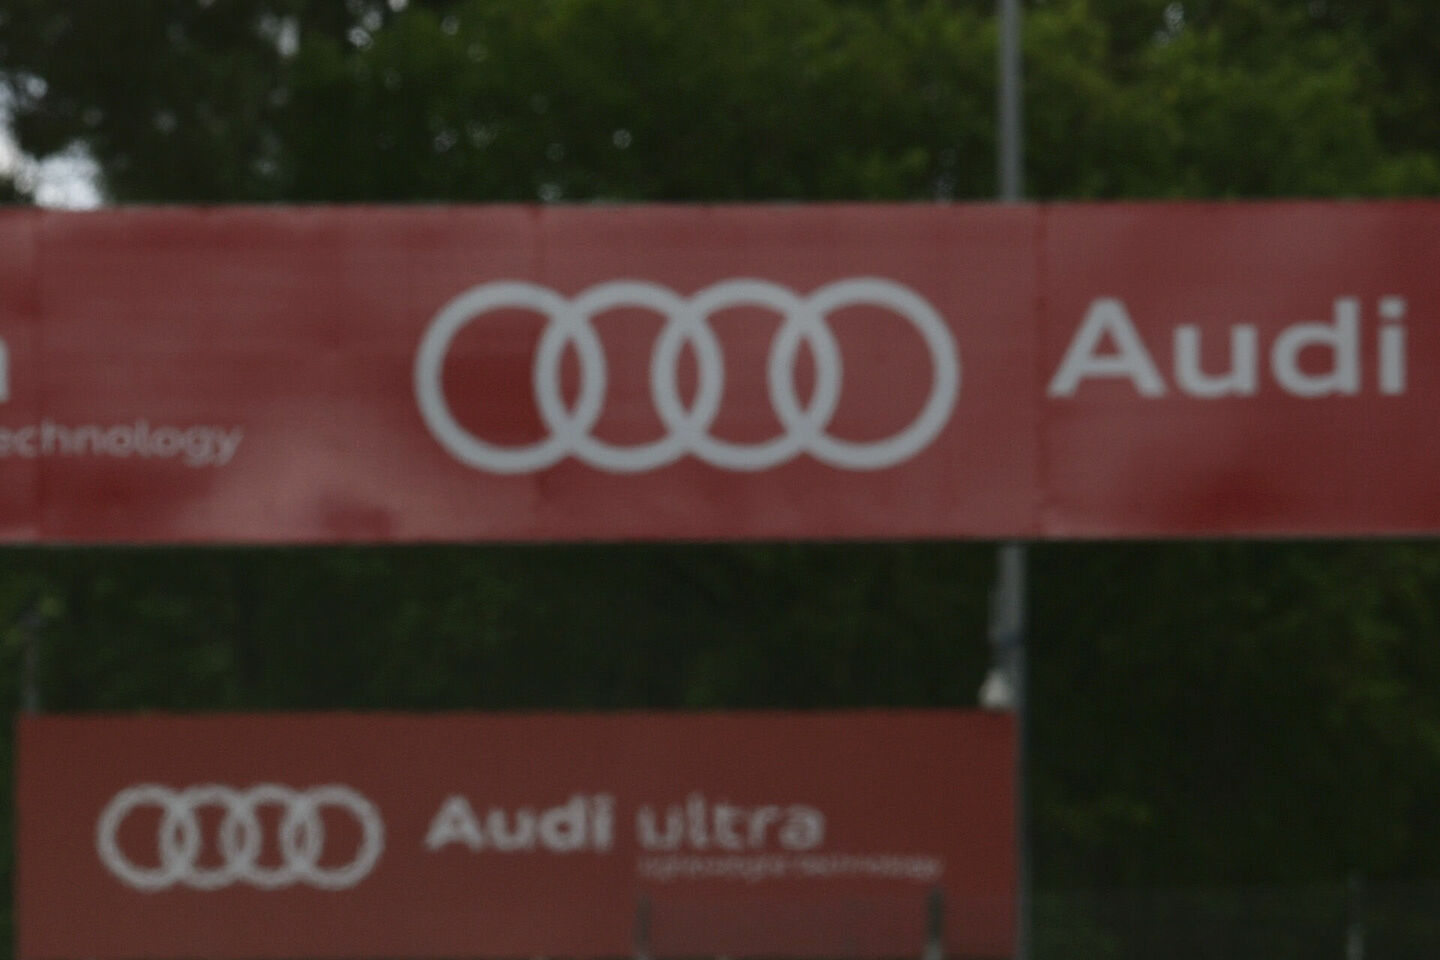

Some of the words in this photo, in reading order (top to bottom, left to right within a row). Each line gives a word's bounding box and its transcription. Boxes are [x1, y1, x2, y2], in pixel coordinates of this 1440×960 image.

[1046, 295, 1408, 399] Audi
[423, 793, 616, 852] Audi
[634, 791, 827, 851] ultra
